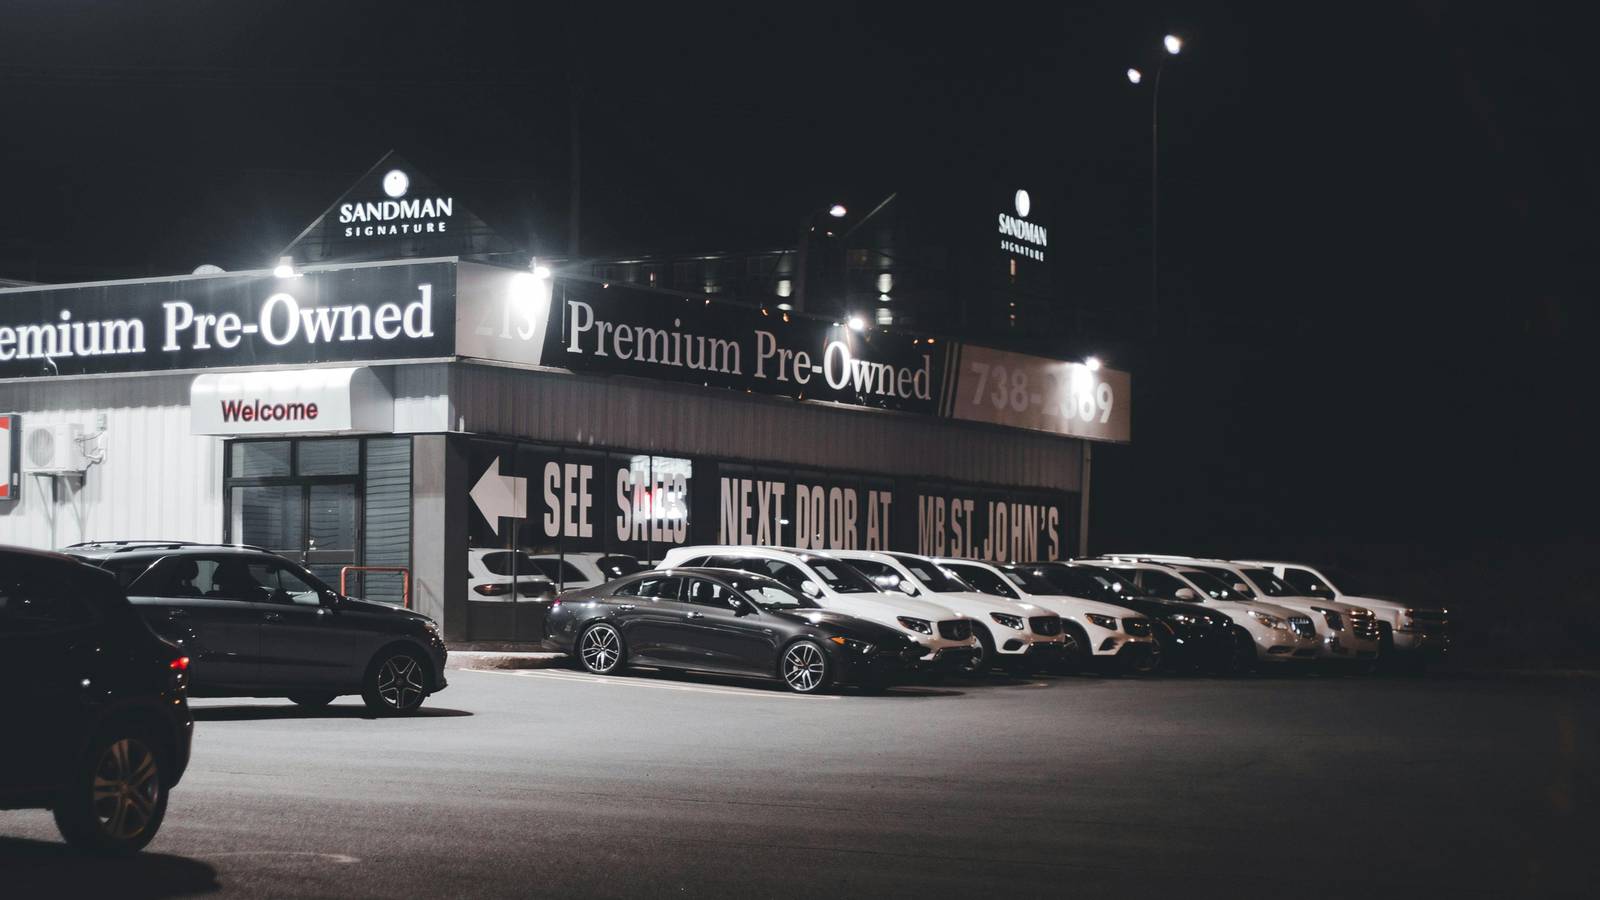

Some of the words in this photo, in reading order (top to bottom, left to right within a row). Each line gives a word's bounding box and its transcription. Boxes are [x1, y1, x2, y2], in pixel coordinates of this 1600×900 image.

[339, 197, 453, 223] SANDMAN
[345, 222, 447, 237] SIGNATURE
[998, 212, 1047, 247] SANDMAN
[1001, 240, 1044, 262] SIGNATURE
[162, 284, 434, 351] Pre-Owned
[566, 300, 742, 376] Premium
[754, 329, 932, 401] Pre-Owned
[221, 398, 319, 423] Welcome
[543, 461, 593, 538] SEE
[616, 468, 687, 544] SALES
[720, 477, 786, 547] NEXT
[795, 484, 858, 551] DOOR
[866, 490, 892, 552] AT
[918, 495, 946, 557] MB
[983, 501, 1059, 563] JOHN'S
